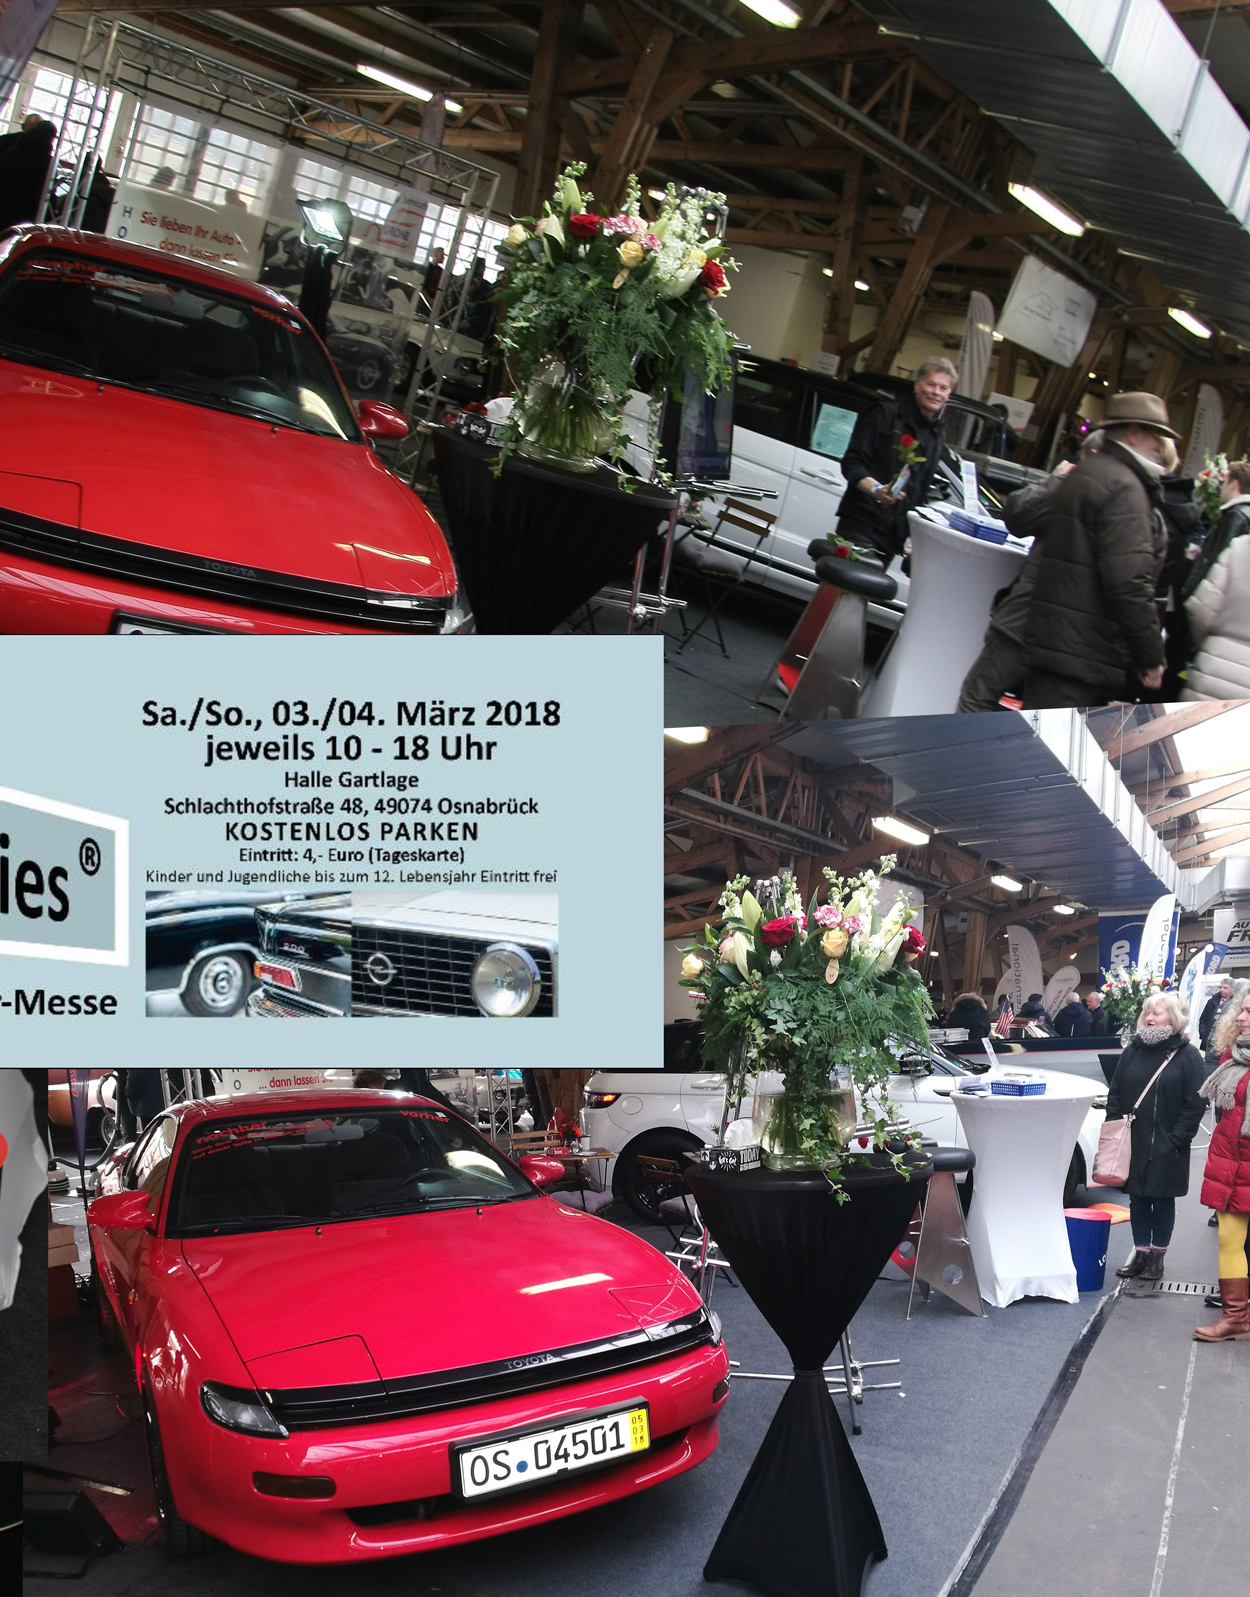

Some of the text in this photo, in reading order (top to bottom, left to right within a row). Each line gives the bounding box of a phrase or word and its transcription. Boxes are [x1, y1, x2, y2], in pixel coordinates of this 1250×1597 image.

[141, 211, 235, 246] Sie lieben Ihr Auto
[159, 238, 187, 254] dann
[251, 304, 303, 335] vorher
[203, 560, 258, 579] TOYOTA
[269, 1077, 292, 1089] dann
[293, 1075, 319, 1086] lassen
[399, 1110, 450, 1123] vorher
[196, 1121, 268, 1144] nachher
[192, 1139, 232, 1155] Dank dem
[192, 1151, 206, 1160] auf
[207, 1145, 231, 1155] dieser
[233, 1140, 252, 1148] Seite
[740, 1146, 761, 1163] TODAY
[504, 1353, 555, 1370] TOYOTA
[631, 1414, 643, 1425] 05
[632, 1425, 644, 1435] 03
[633, 1435, 645, 1445] 18
[470, 1421, 626, 1487] OS 04501
